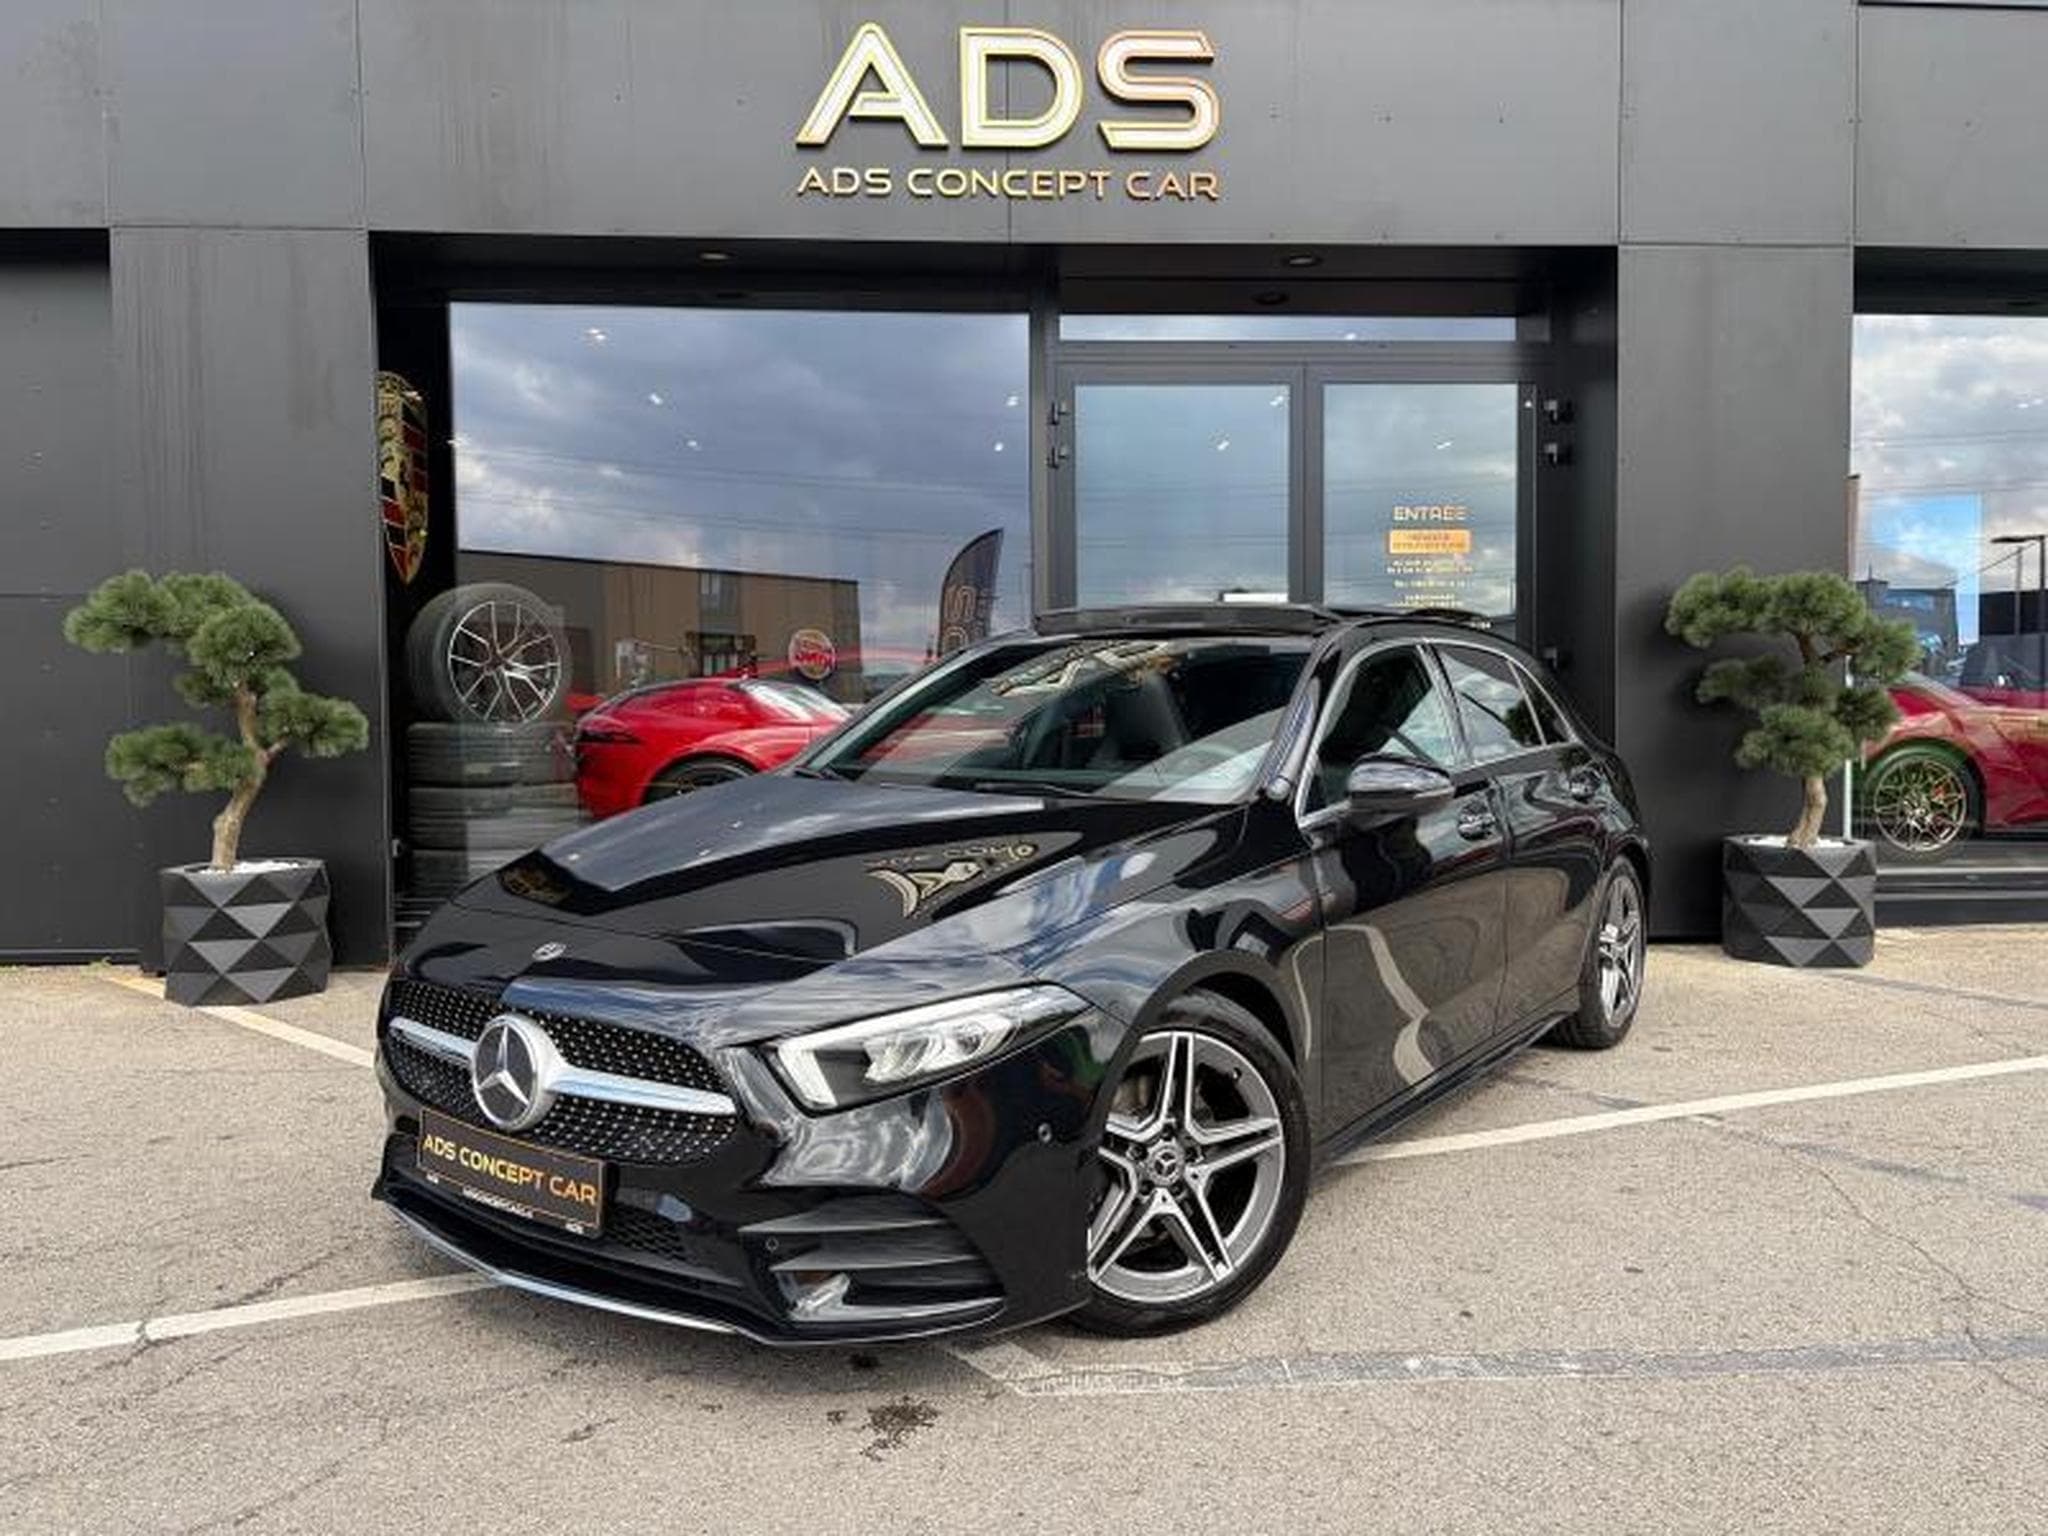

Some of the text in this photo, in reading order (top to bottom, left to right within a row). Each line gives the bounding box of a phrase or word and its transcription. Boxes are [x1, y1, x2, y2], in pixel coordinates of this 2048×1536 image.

[795, 20, 1220, 151] ADS
[797, 167, 1219, 201] ADS CONCEPT CAR
[422, 1133, 457, 1162] ADS
[458, 1146, 546, 1190] CONCEPT
[549, 1175, 598, 1206] CAR
